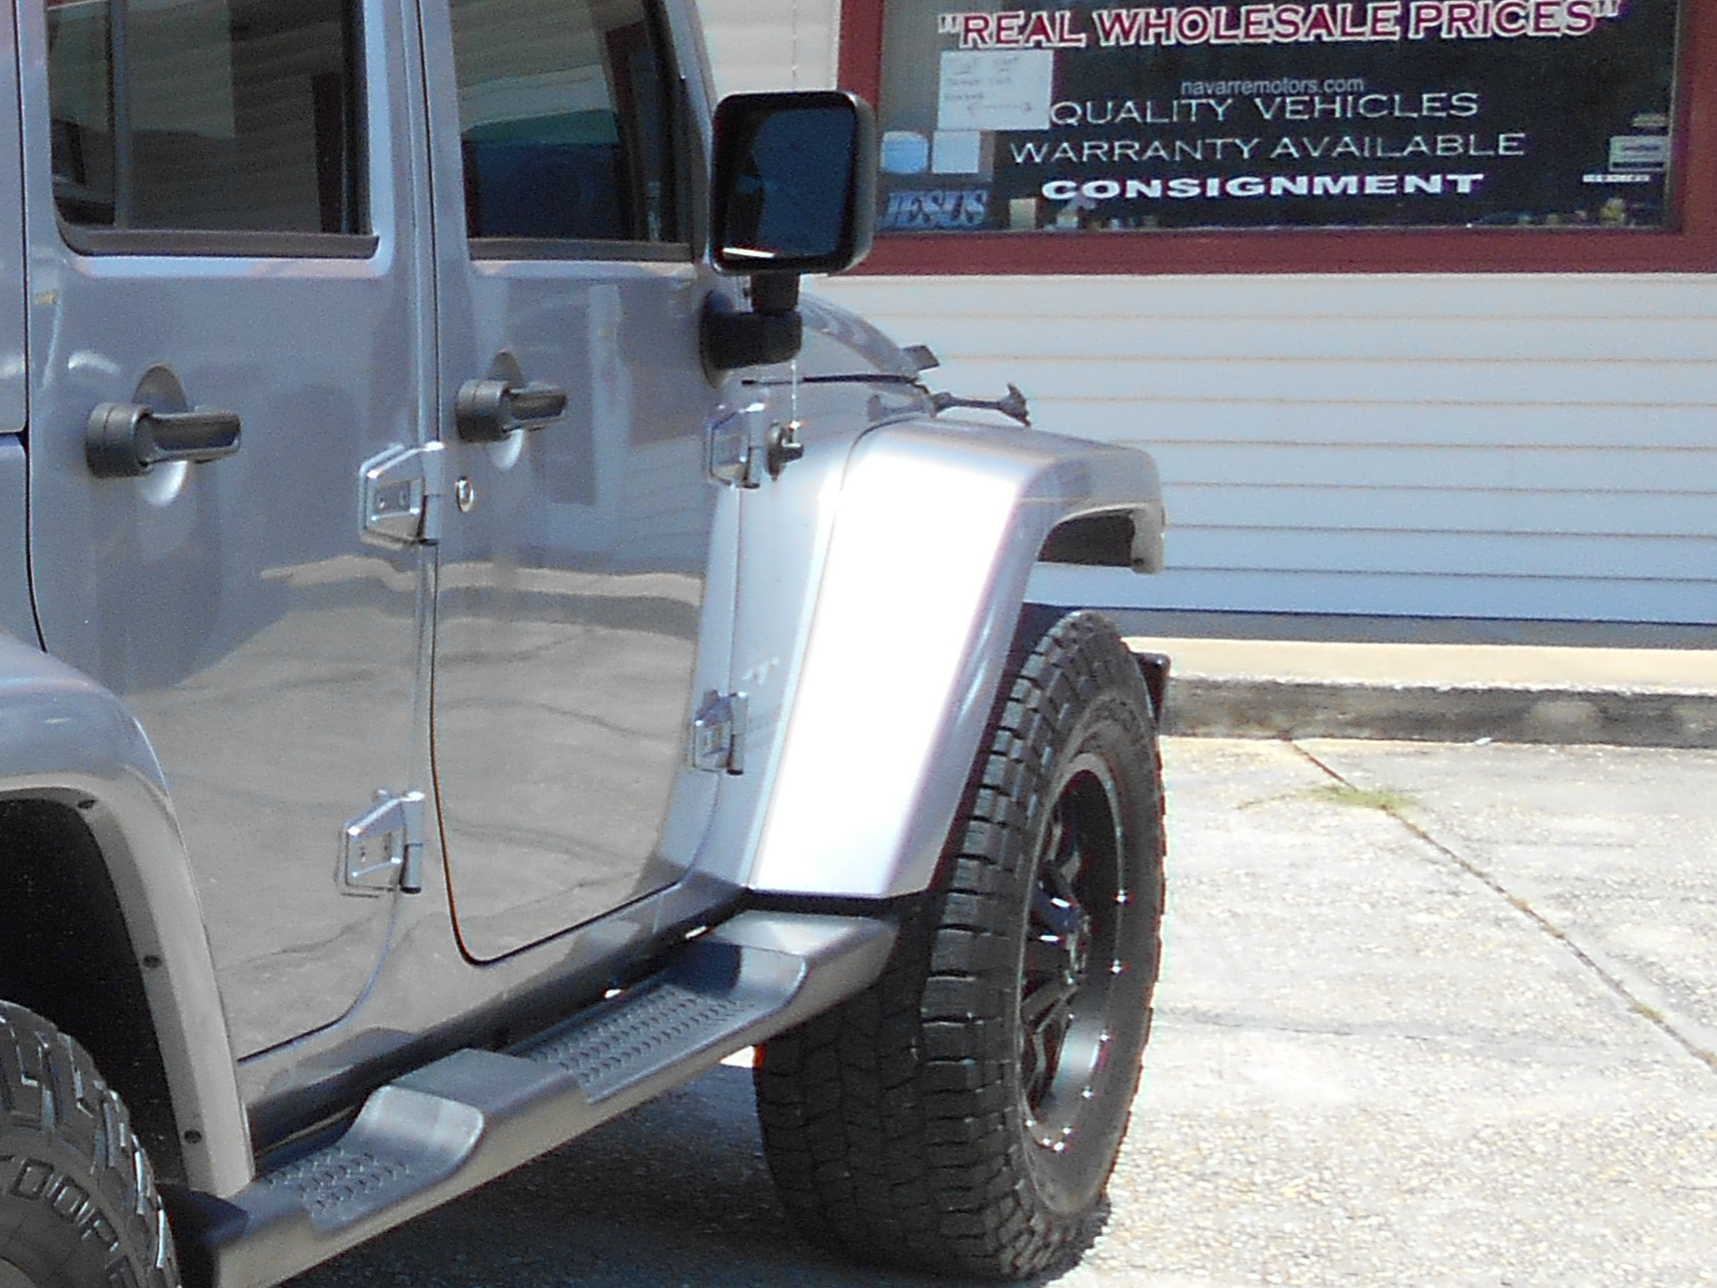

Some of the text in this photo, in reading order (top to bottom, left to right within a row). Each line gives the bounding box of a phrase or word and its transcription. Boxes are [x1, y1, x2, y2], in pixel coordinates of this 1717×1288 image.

[1092, 0, 1401, 46] WHOLESALE
[1180, 76, 1365, 97] navarremotors.com
[1049, 92, 1480, 125] QUALITY VEHICLES
[1009, 132, 1527, 164] WARRANTY AVAILABLE
[1041, 173, 1484, 201] CONSIGNMENT
